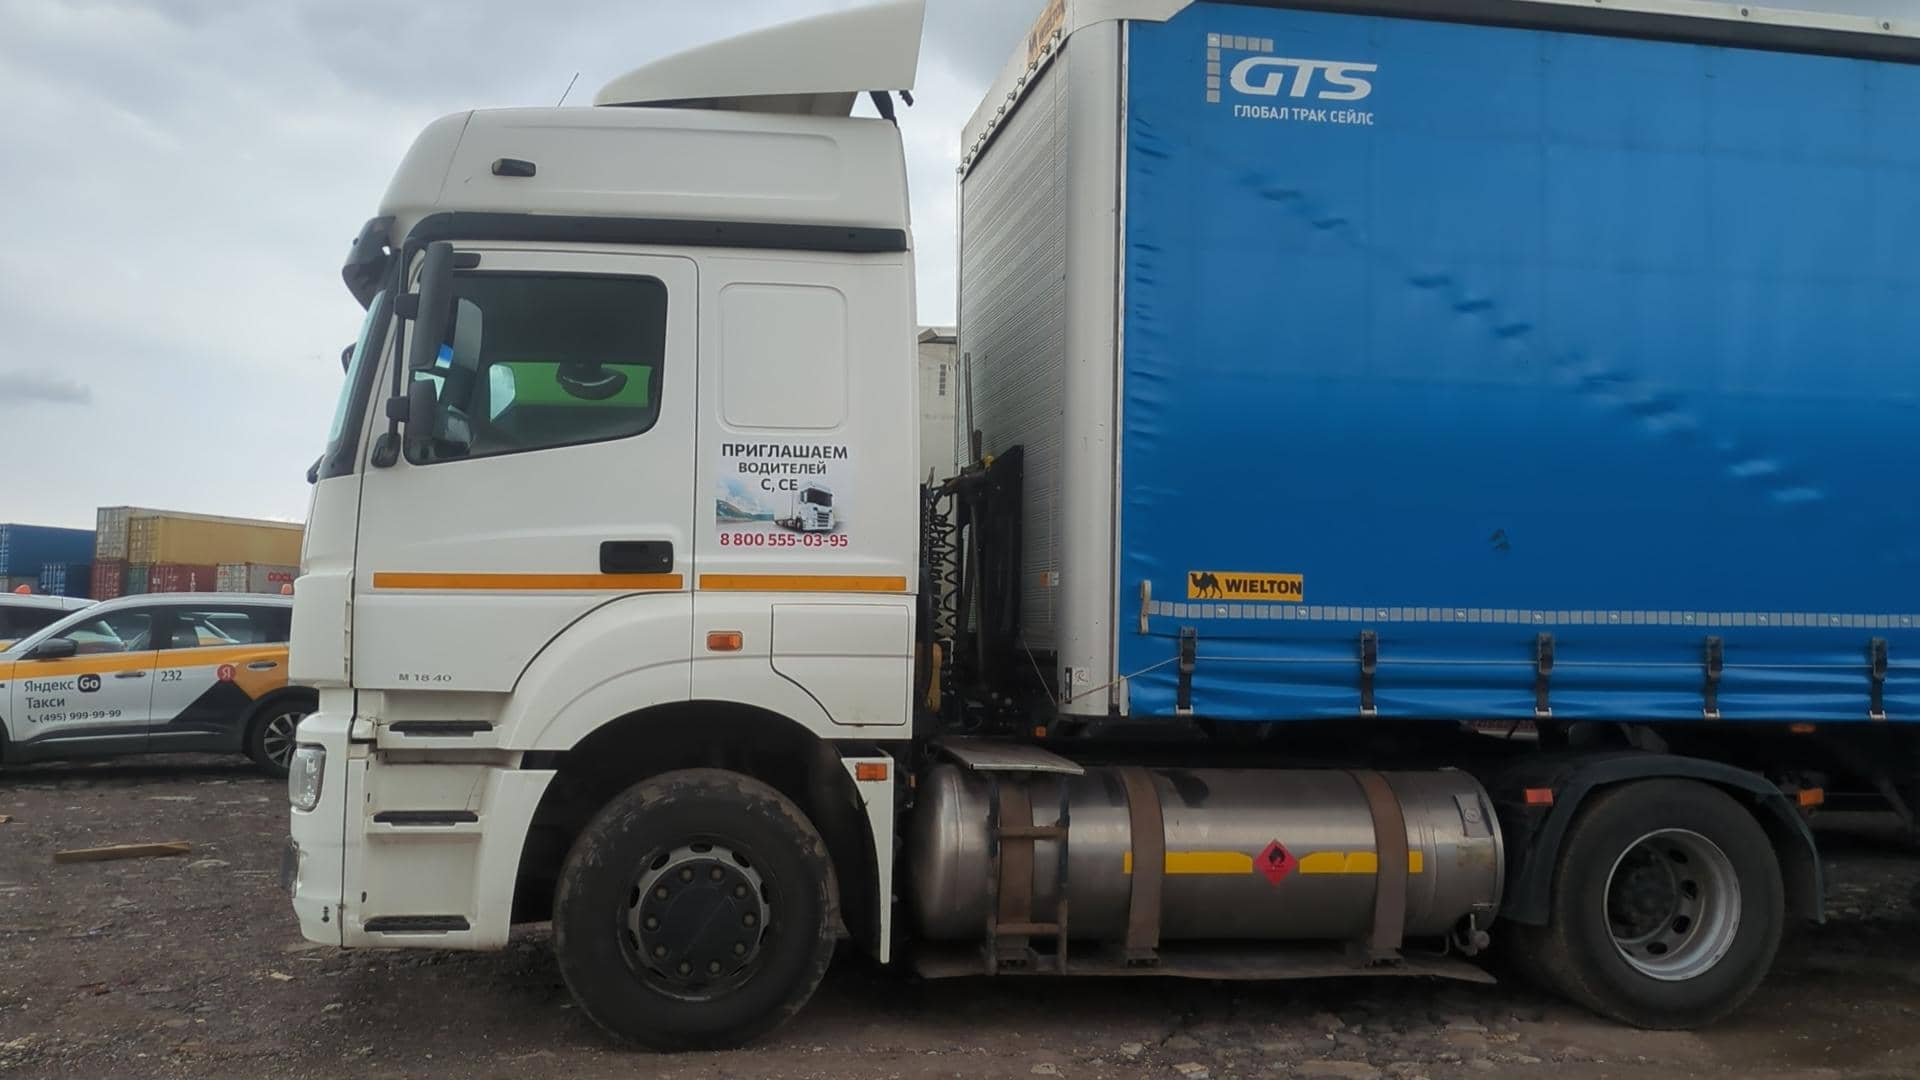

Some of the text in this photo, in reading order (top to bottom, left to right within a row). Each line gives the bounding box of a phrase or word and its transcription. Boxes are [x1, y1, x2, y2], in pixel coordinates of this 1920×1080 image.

[1230, 56, 1378, 101] GTS
[1234, 104, 1374, 125] ГЛОБАЛ ТРАК СЕЙЛС
[722, 443, 848, 459] ПРИГЛАШАЕМ
[738, 461, 827, 475] ВОДИТЕЛЕЙ
[720, 533, 848, 547] 8 800 555-03-95
[1225, 579, 1302, 595] WIELTON
[161, 670, 182, 682] 232
[399, 673, 409, 681] M
[24, 680, 75, 693] Яндекс
[25, 697, 65, 709] Такси
[39, 709, 121, 723] (495) 999-99-99
